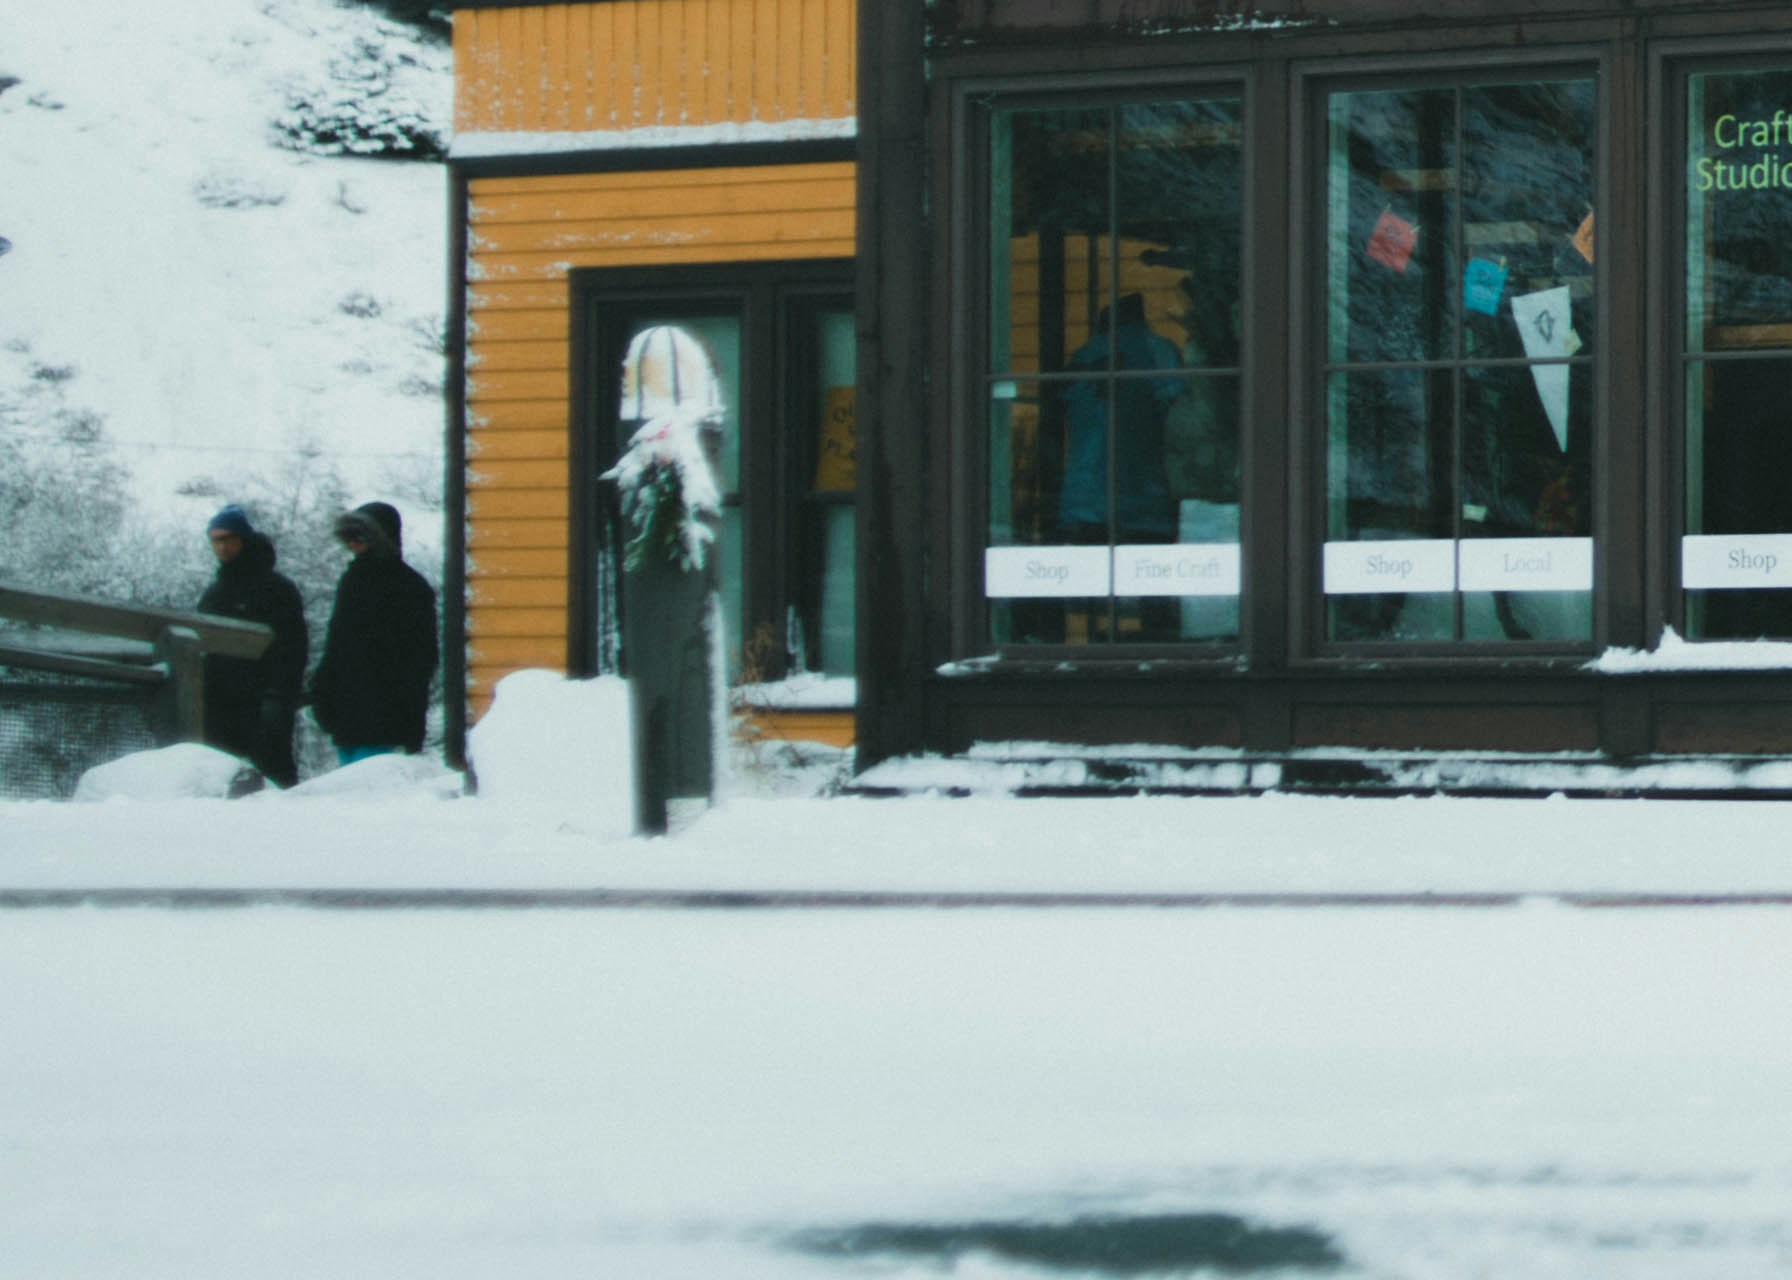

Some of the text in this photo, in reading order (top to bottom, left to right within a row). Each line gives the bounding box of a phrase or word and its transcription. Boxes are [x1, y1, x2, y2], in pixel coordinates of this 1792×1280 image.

[1024, 558, 1221, 583] Shop Fine Craft
[1365, 552, 1552, 578] Shop Local
[1728, 548, 1778, 573] Shop
